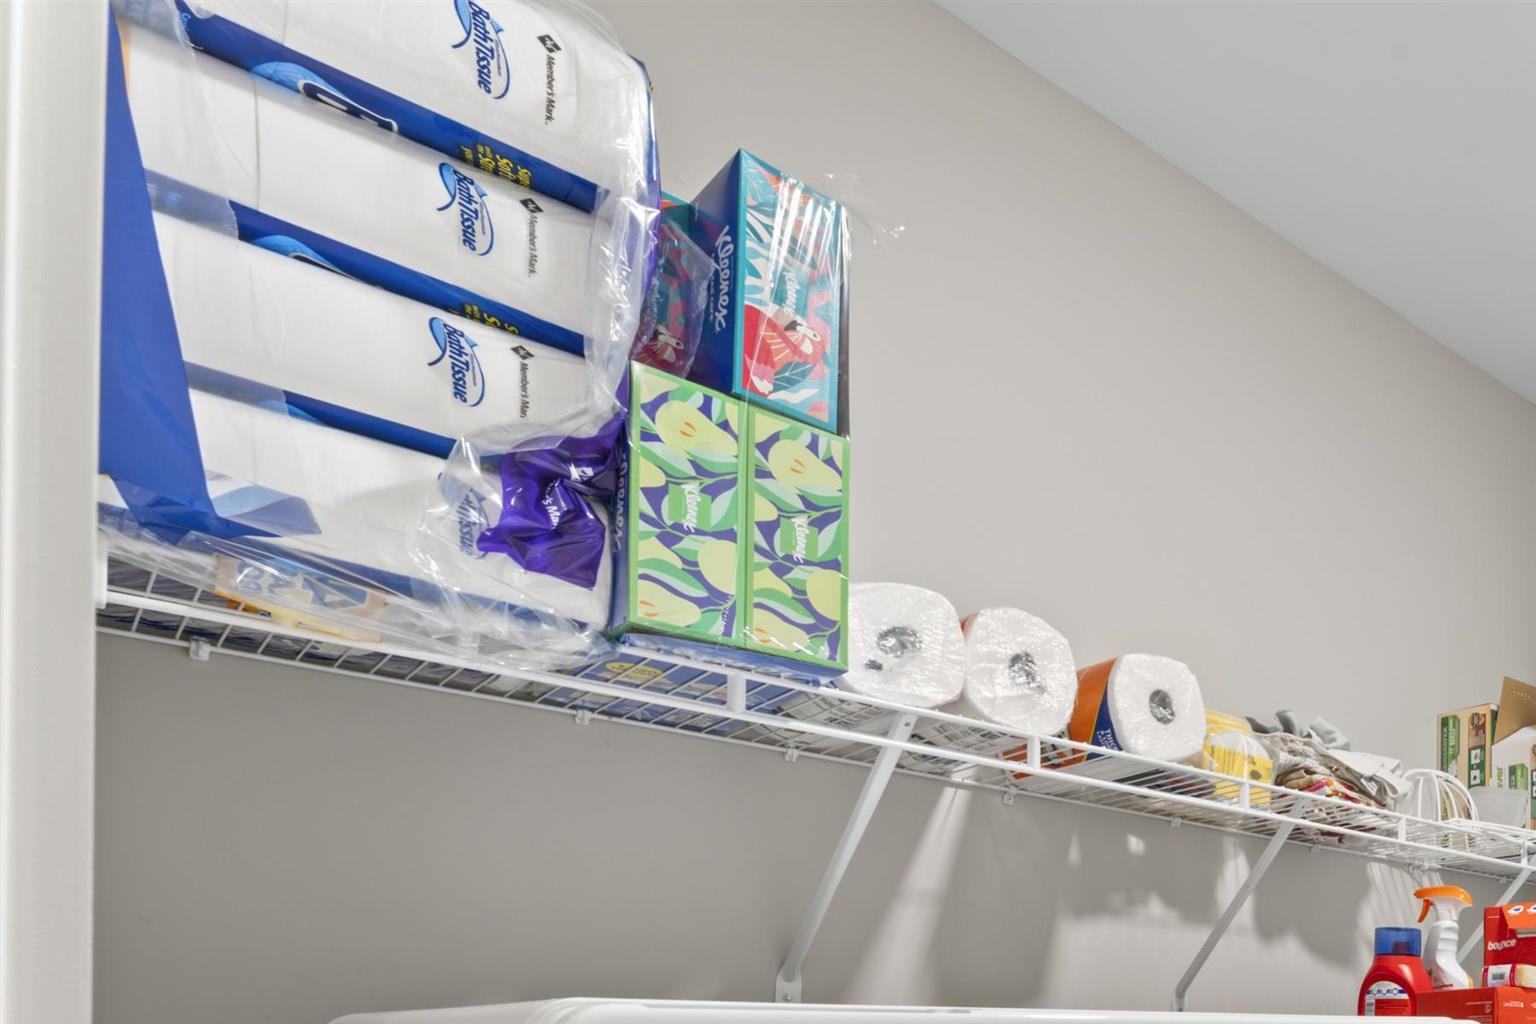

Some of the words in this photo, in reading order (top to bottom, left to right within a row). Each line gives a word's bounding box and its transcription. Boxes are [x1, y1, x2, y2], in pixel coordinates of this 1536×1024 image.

[468, 0, 494, 44] Bath
[474, 40, 496, 95] Tissue
[545, 54, 556, 97] Member's
[545, 96, 556, 122] Mark
[453, 169, 476, 205] Bath
[458, 199, 480, 252] Tissue
[528, 213, 539, 250] Member's
[528, 249, 539, 275] Mark
[714, 225, 735, 332] Kleenex
[443, 322, 466, 351] Bath
[449, 347, 471, 404] Tissue
[519, 361, 531, 399] Member's
[681, 483, 701, 533] Kleenex
[791, 515, 809, 564] Kleenex
[1488, 939, 1516, 950] bounce
